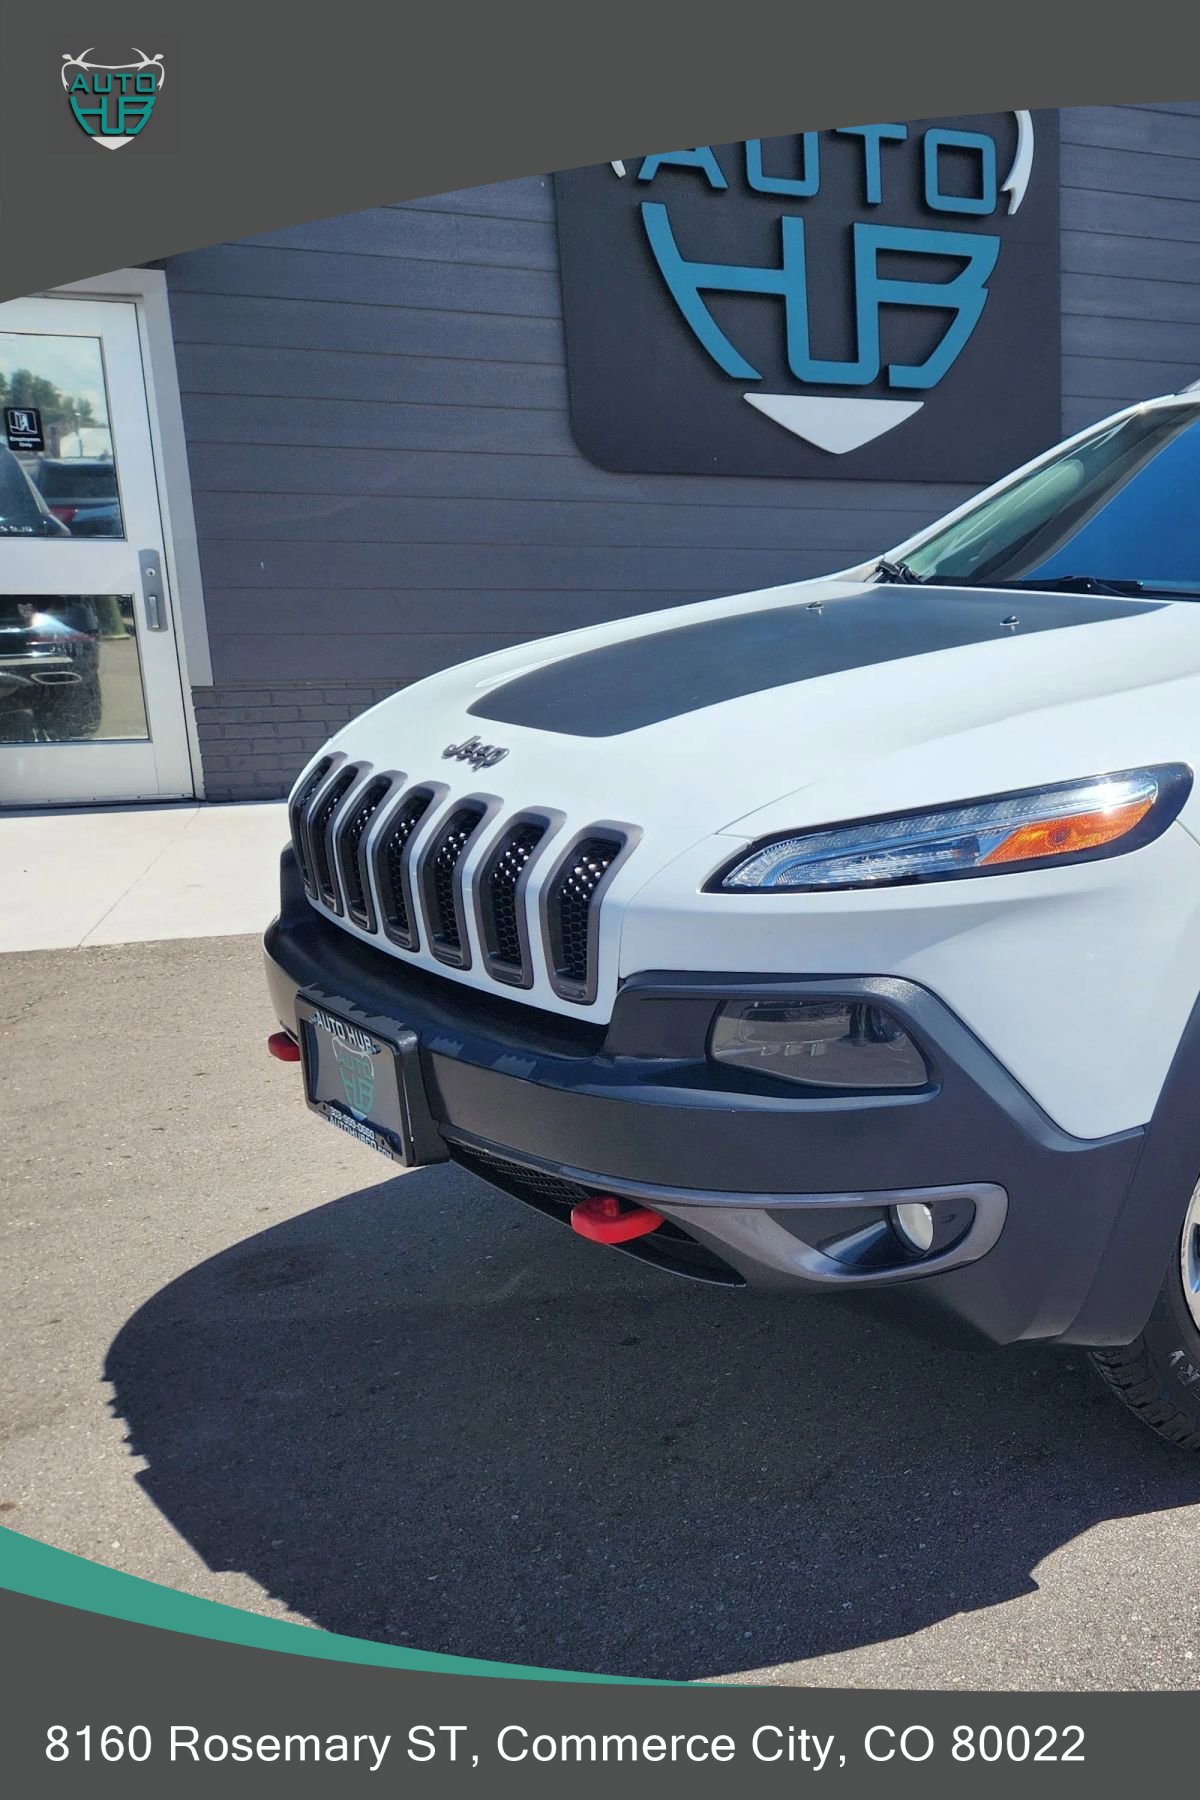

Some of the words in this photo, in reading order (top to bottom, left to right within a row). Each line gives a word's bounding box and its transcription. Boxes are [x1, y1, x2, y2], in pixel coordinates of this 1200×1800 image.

[640, 201, 1001, 390] HUB
[441, 734, 511, 773] Jeep
[315, 1009, 346, 1040] AUTO
